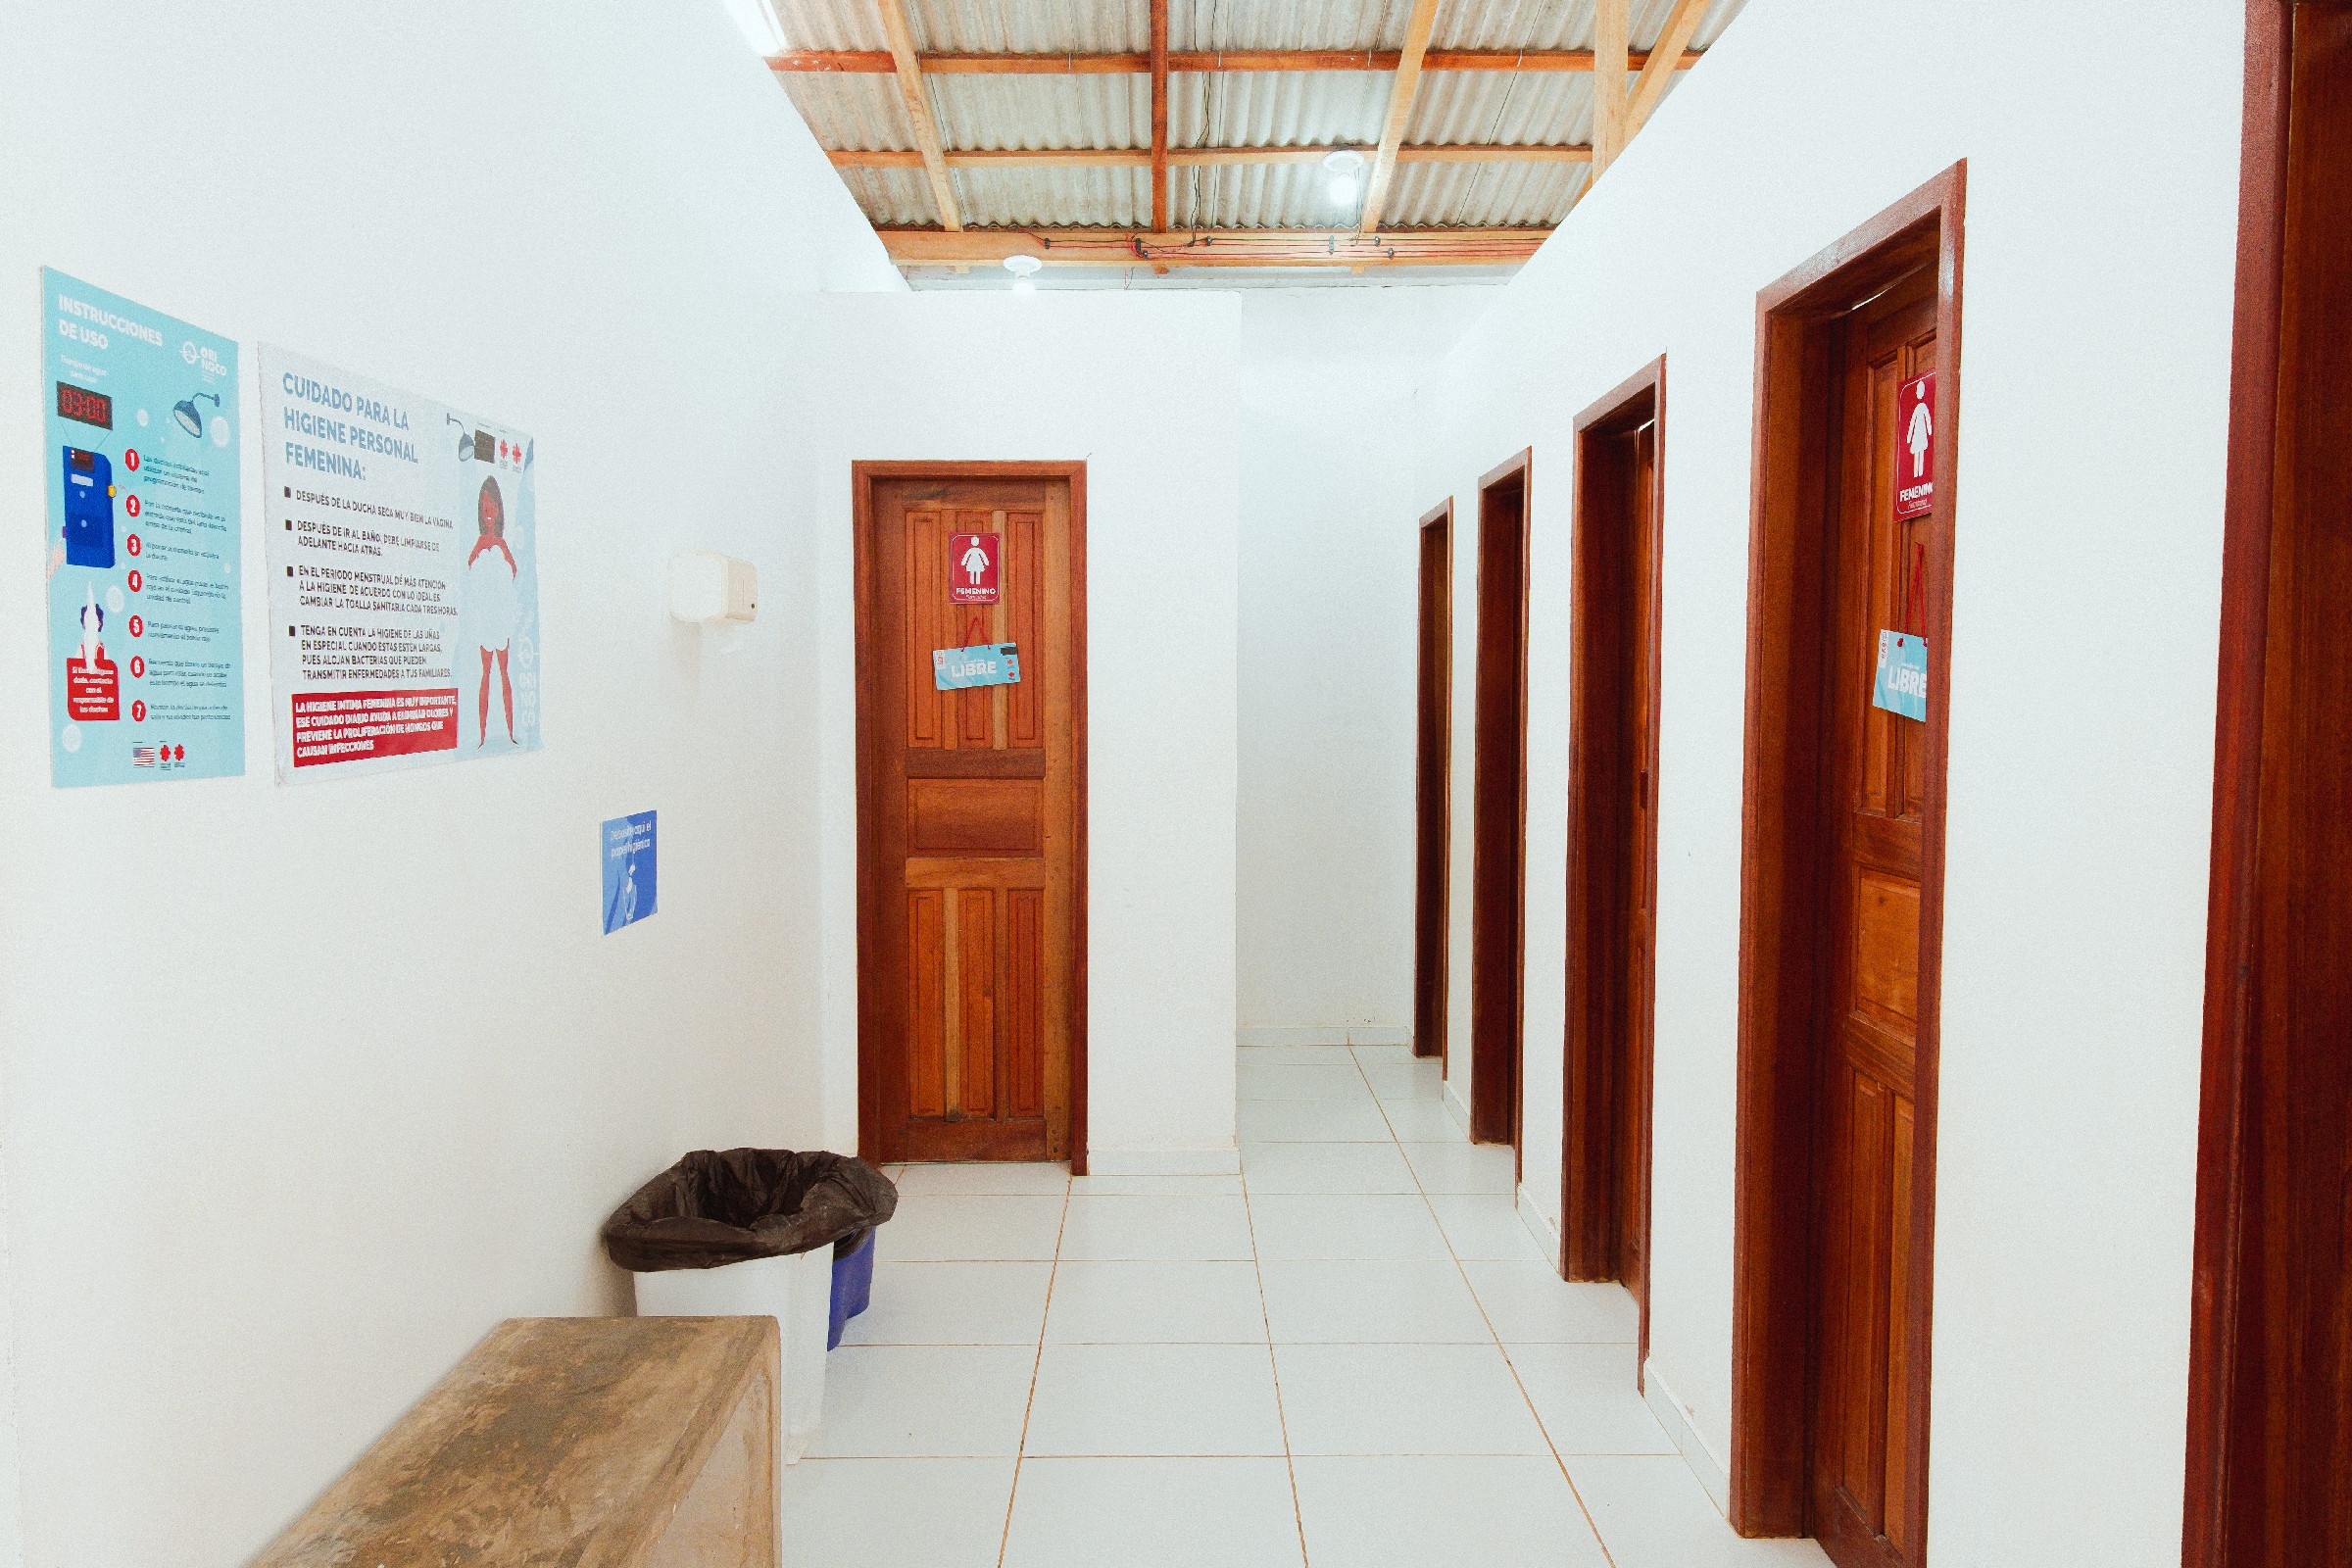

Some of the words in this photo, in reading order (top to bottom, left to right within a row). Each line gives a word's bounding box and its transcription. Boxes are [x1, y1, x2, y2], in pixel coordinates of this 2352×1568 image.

[59, 294, 163, 346] INSTRUCCIONES
[59, 318, 77, 339] DE
[79, 325, 108, 349] USO
[63, 389, 106, 422] 03:00
[283, 372, 353, 413] CUIDADO
[357, 395, 390, 425] PARA
[394, 408, 410, 431] LA
[284, 406, 347, 444] HIGIENE
[350, 425, 418, 465] PERSONAL
[286, 441, 367, 480] FEMENINA:
[297, 490, 330, 506] DESPUÉS
[331, 497, 340, 508] DE
[342, 499, 352, 510] LA
[353, 501, 377, 515] DUCHA
[395, 510, 409, 520] MUY
[425, 515, 432, 525] LA
[297, 520, 331, 535] DESPUÉS
[332, 525, 342, 537] DE
[344, 527, 351, 538] IR
[352, 530, 361, 540] AL
[298, 535, 337, 551] ADELANTE
[337, 541, 360, 554] HACIA
[299, 564, 310, 576] EN
[311, 567, 320, 577] EL
[321, 567, 353, 581] PERIODO
[354, 571, 394, 586] MENSTRUAL
[299, 579, 305, 591] A
[306, 581, 316, 592] LA
[317, 581, 347, 595] HIGIENE
[349, 584, 359, 596] DE
[360, 586, 391, 598] ACUERDO
[392, 589, 406, 600] CON
[407, 591, 416, 600] LO
[433, 593, 441, 603] ES
[956, 587, 997, 596] FEMENINO
[299, 595, 333, 608] CAMBIAR
[334, 598, 344, 609] LA
[345, 598, 371, 611] TOALLA
[372, 601, 405, 612] SANITARIA
[406, 604, 422, 613] CADA
[423, 605, 438, 614] TRES
[301, 624, 325, 636] TENGA
[327, 626, 337, 637] EN
[338, 627, 367, 638] CUENTA
[368, 628, 376, 638] LA
[377, 628, 403, 639] HIGIENE
[403, 629, 412, 639] DE
[413, 629, 423, 639] LAS
[301, 640, 312, 651] EN
[313, 640, 347, 651] ESPECIAL
[348, 641, 377, 652] CUANDO
[302, 654, 321, 665] PUES
[322, 655, 351, 665] ALOJAN
[351, 655, 388, 665] BACTERIAS
[388, 656, 402, 665] QUE
[403, 656, 427, 665] PUEDEN
[951, 661, 998, 679] LIBRE
[302, 669, 347, 680] TRANSMITIR
[348, 669, 400, 679] ENFERMEDADES
[400, 668, 405, 679] A
[406, 668, 417, 678] TUS
[1887, 664, 1927, 699] LIBRE
[295, 702, 307, 713] LA
[306, 700, 337, 712] HIGIENE
[363, 697, 396, 710] FEMENINA
[396, 697, 405, 708] ES
[405, 696, 419, 707] MUY
[295, 715, 311, 729] ESE
[311, 714, 345, 727] CUIDADO
[345, 712, 369, 724] DIARIO
[369, 710, 392, 722] AYUDA
[392, 710, 398, 721] A
[397, 709, 426, 720] ELIMINAR
[449, 707, 454, 717] Y
[296, 728, 333, 743] PREVIENE
[333, 728, 343, 740] LA
[395, 723, 405, 734] DE
[405, 721, 431, 733] HONGOS
[431, 720, 444, 731] QUE
[297, 744, 328, 759] CAUSAN
[328, 739, 374, 755] INFECCIONES
